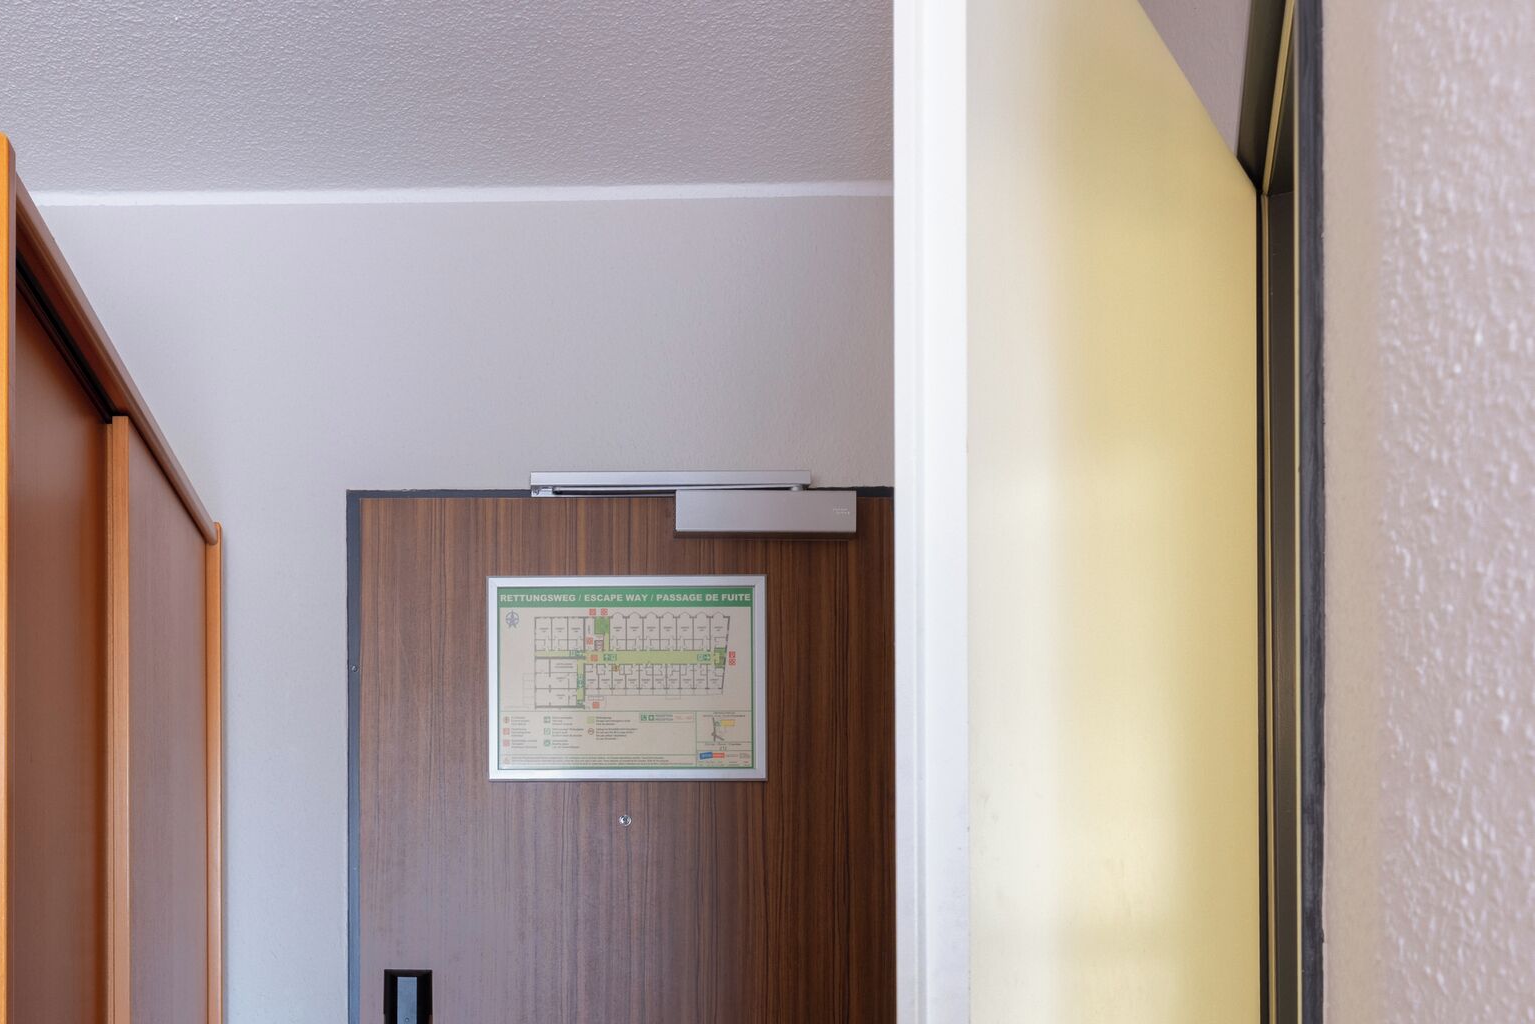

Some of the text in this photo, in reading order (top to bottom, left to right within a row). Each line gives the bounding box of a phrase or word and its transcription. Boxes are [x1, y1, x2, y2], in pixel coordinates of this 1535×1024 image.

[500, 594, 576, 602] RETTUNGSWEG
[584, 594, 623, 602] ESCAPE
[626, 594, 648, 602] WAY
[656, 593, 703, 602] PASSAGE
[705, 593, 719, 601] DE
[721, 593, 751, 601] FUITE
